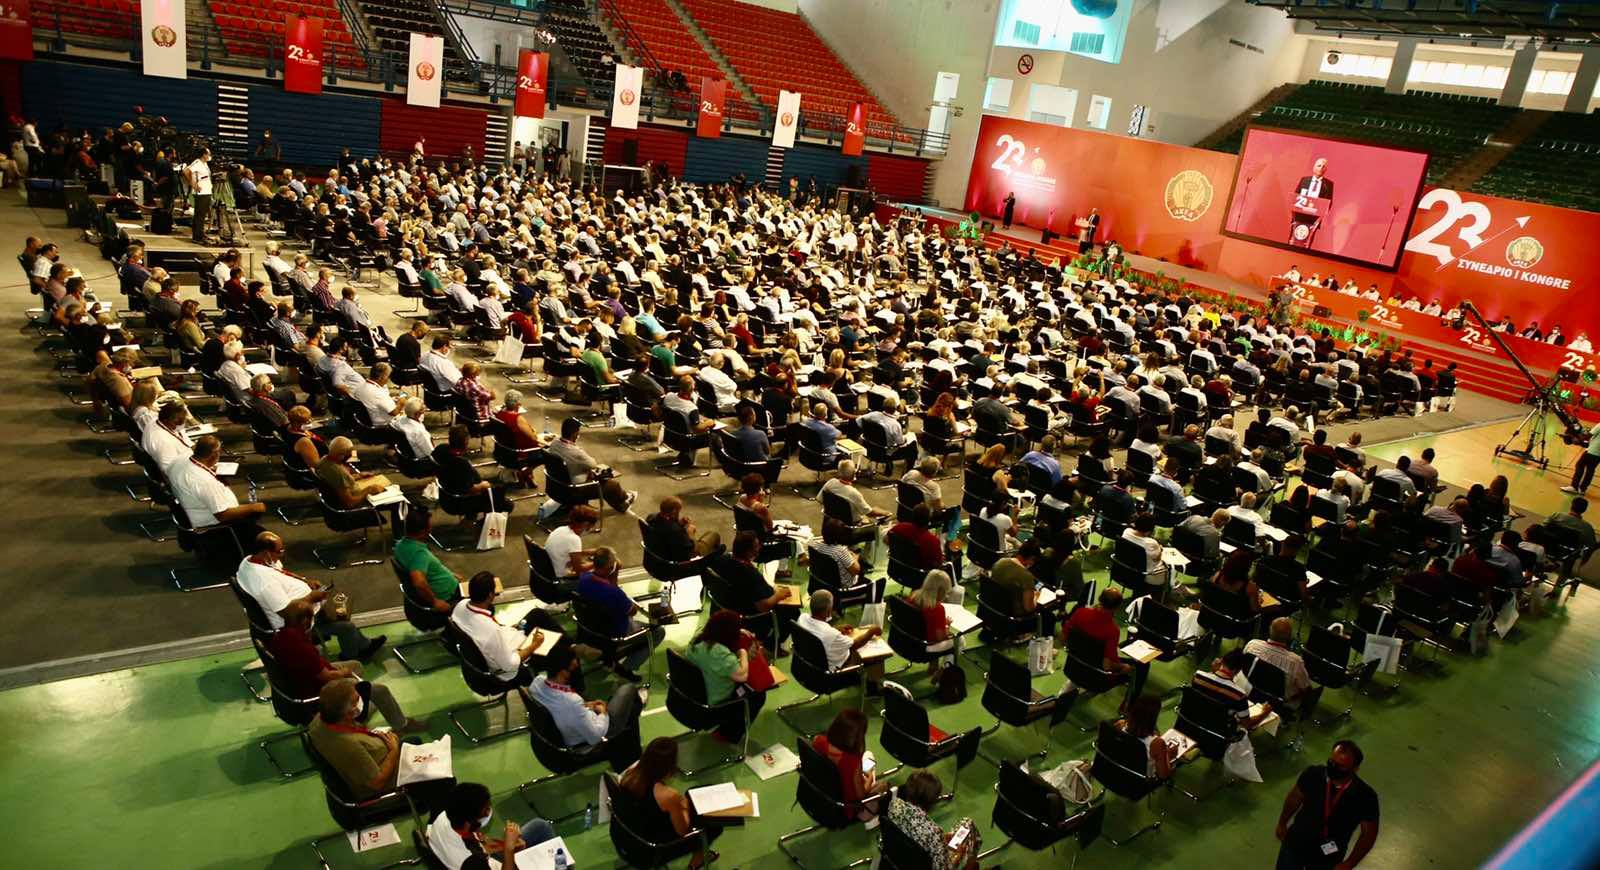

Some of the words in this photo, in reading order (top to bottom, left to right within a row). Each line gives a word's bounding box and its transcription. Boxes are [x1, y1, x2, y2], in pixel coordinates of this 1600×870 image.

[991, 134, 1025, 176] 23
[1404, 188, 1491, 266] 23
[1457, 259, 1513, 278] ΣΥΝΕΔΡΙΟ
[1521, 272, 1571, 290] KONGRE
[1370, 304, 1389, 321] 23
[1460, 327, 1480, 345] 23
[1561, 352, 1584, 370] 23
